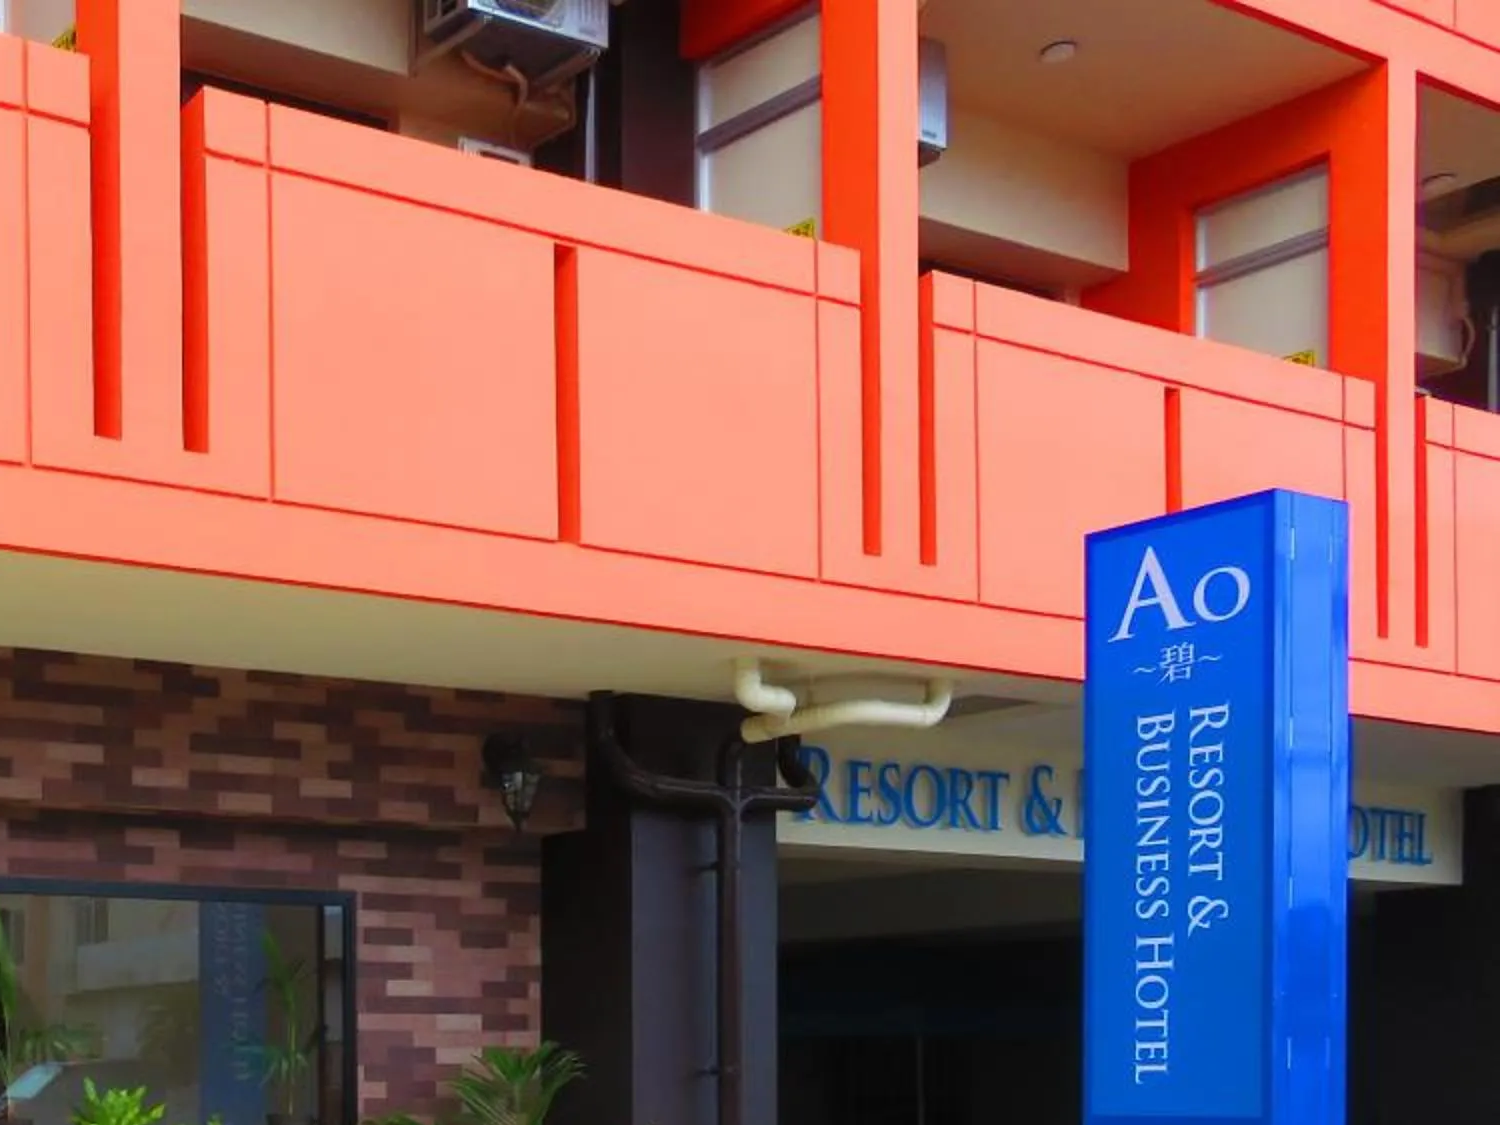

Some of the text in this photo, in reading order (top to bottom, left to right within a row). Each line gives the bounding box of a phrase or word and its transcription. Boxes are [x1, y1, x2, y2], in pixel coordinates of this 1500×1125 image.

[1108, 545, 1251, 643] Ao
[794, 744, 1009, 832] RESORT
[1023, 764, 1068, 837] &
[1187, 702, 1230, 940] RESORT &
[1347, 804, 1433, 867] OTEL
[1135, 710, 1176, 1085] BUSINESS HOTEL
